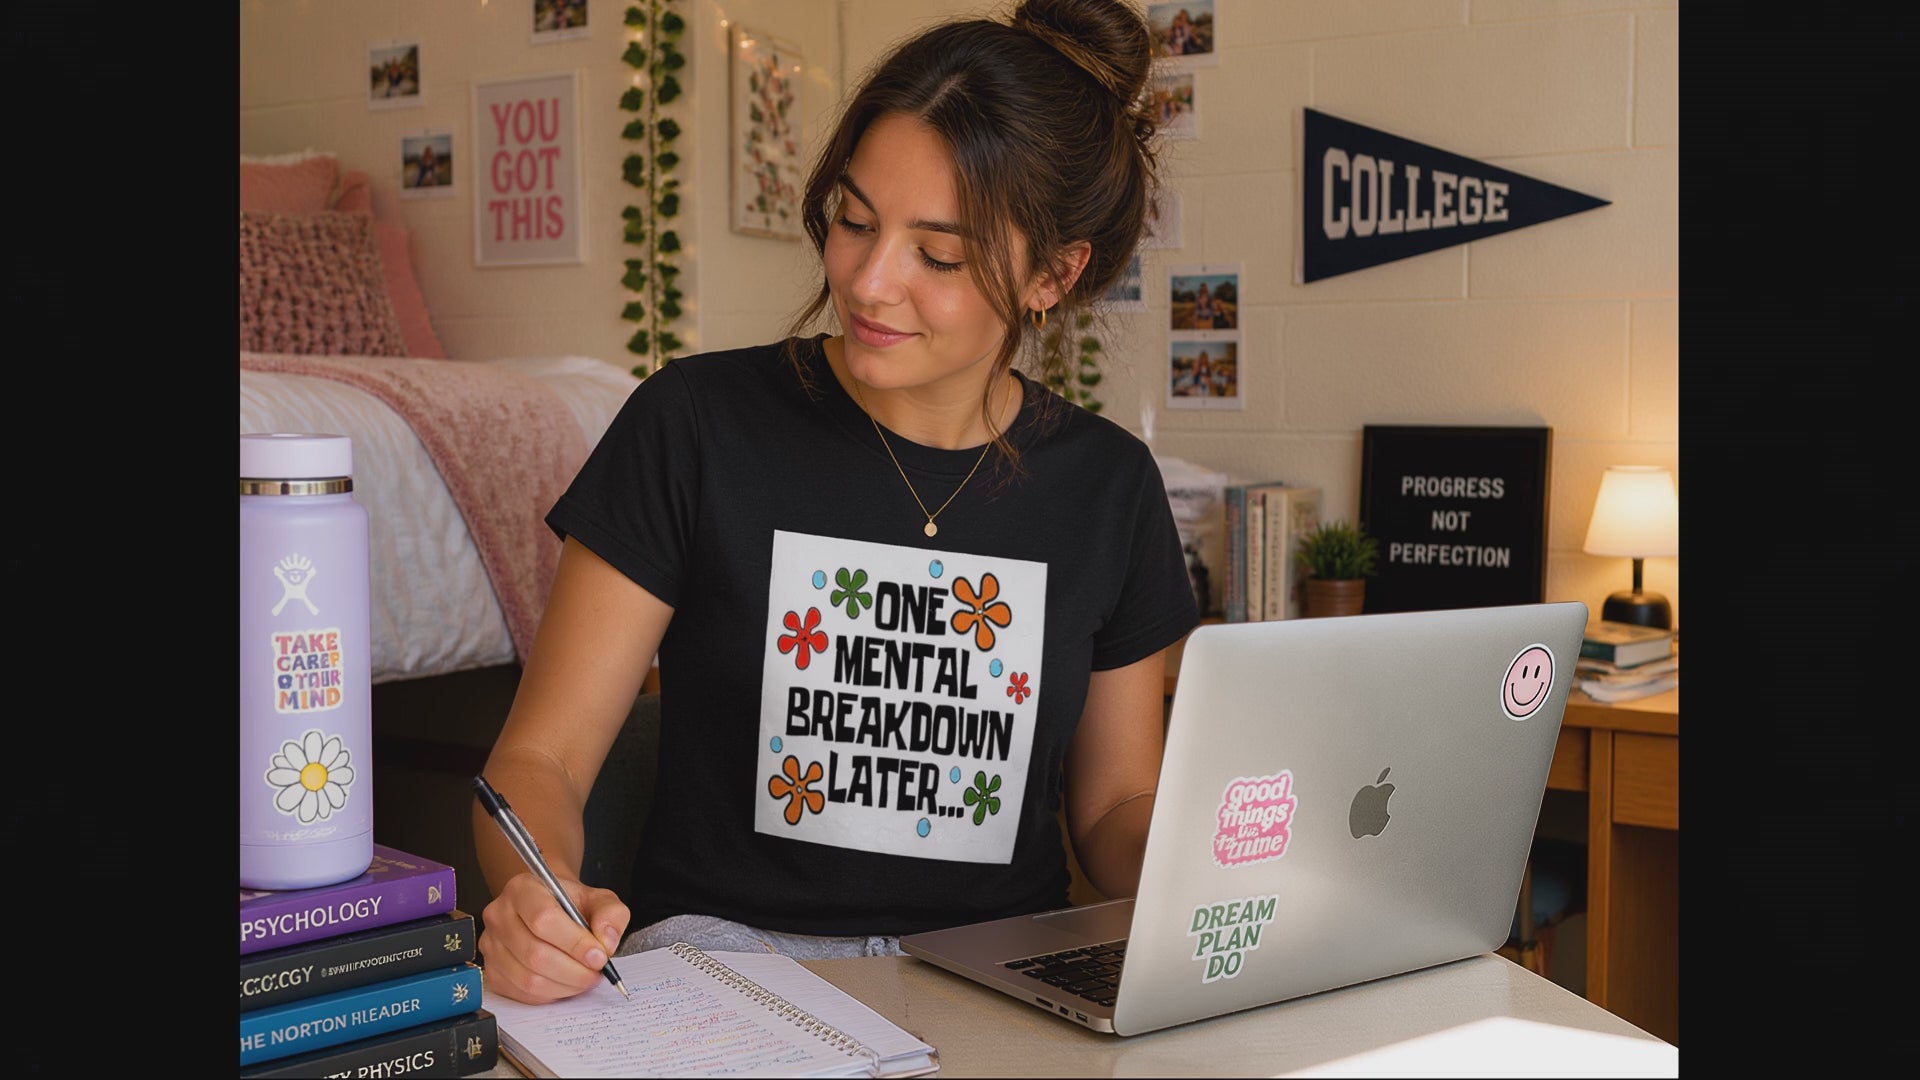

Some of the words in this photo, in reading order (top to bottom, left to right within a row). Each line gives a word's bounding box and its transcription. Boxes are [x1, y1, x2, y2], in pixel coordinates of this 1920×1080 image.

[490, 98, 560, 146] YOU
[491, 146, 561, 195] GOT
[1323, 147, 1509, 240] COLLEGE
[488, 194, 565, 242] THIS
[1401, 475, 1505, 499] PROGRESS
[1431, 510, 1471, 532] NOT
[1389, 542, 1510, 568] PERFECTION
[875, 581, 949, 635] ONE
[275, 632, 338, 655] TAKE
[834, 635, 977, 700] MENTAL
[279, 687, 341, 710] MIND
[786, 687, 1014, 761] BREAKDOWN
[828, 750, 964, 818] LATER...
[1229, 776, 1288, 813] good
[240, 895, 382, 942] PSYCHOLOGY
[1191, 897, 1276, 932] DREAM
[1196, 923, 1262, 957] PLAN
[1206, 951, 1242, 979] DO
[271, 1014, 347, 1045] NORTON
[358, 1050, 434, 1079] PHYSICS
